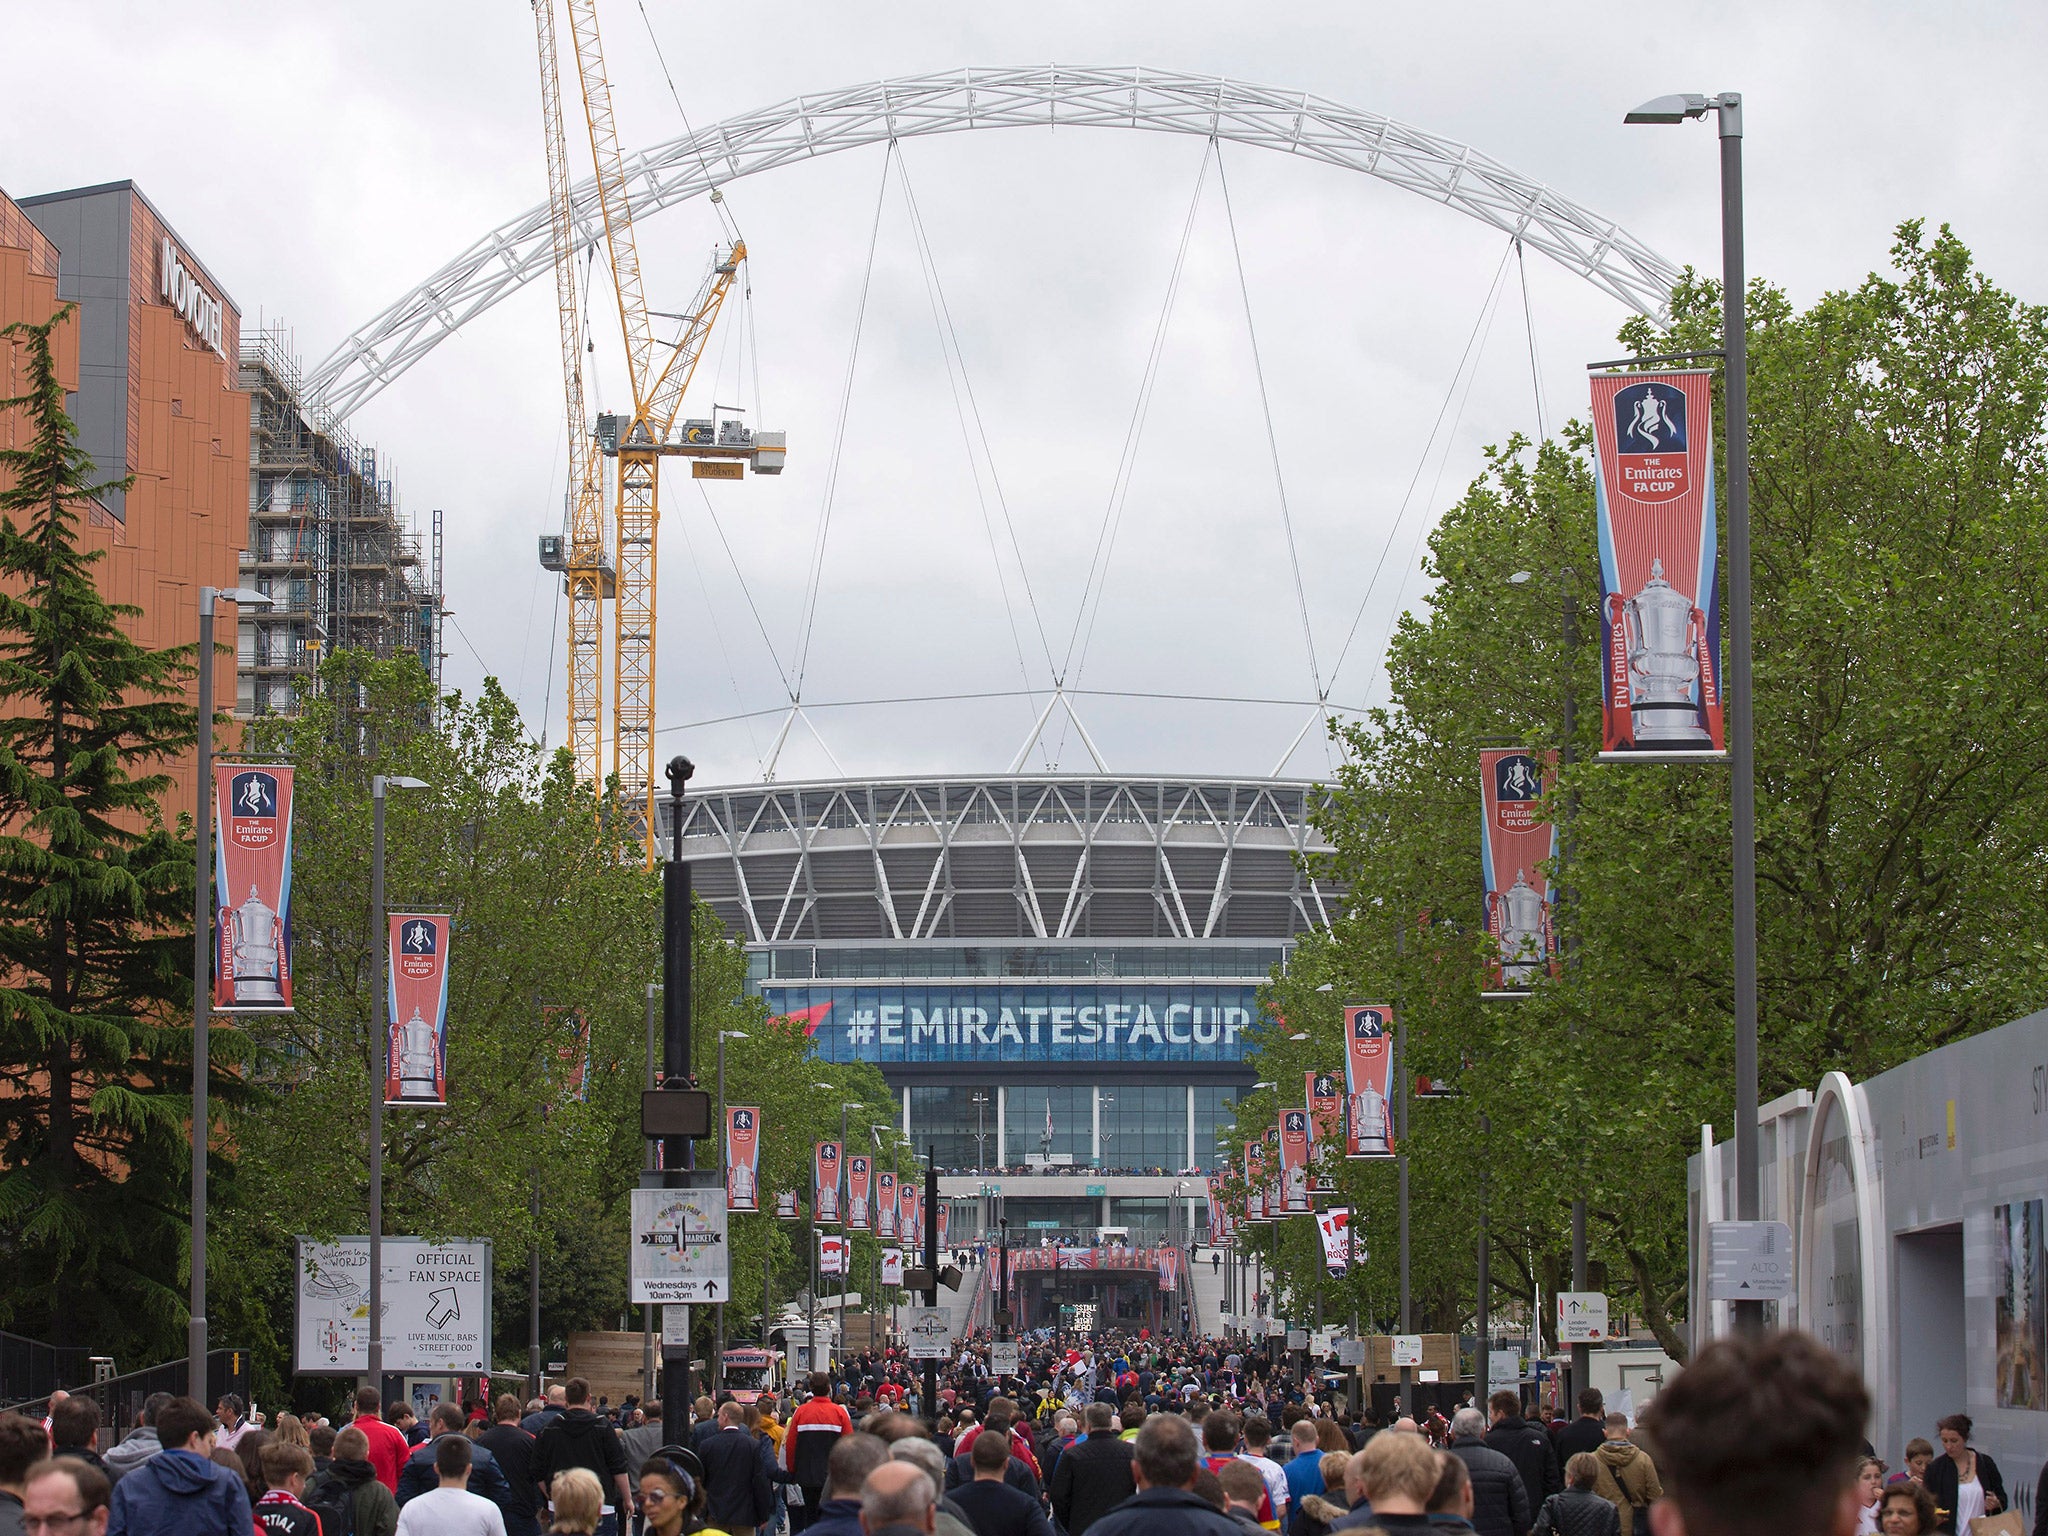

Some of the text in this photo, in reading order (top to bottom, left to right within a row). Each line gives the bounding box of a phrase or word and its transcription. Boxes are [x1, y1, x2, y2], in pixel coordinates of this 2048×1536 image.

[161, 237, 226, 361] NOVOTEL
[1644, 458, 1661, 466] THE
[1624, 466, 1683, 480] Emirates
[1634, 481, 1675, 493] FA CUP
[1613, 622, 1631, 709] Fly Emirates
[1698, 634, 1717, 707] Fly Emirates
[1501, 809, 1534, 818] Emirat
[236, 825, 273, 835] Emirates
[241, 835, 252, 843] FA
[223, 924, 234, 981] Fly Emirates
[278, 934, 287, 966] Emirates
[403, 960, 433, 968] Emirates
[846, 1002, 1250, 1046] #EMIRATESFACUP
[391, 1037, 399, 1068] Emirates
[655, 1234, 712, 1243] FOOD MARKET
[330, 1256, 368, 1268] WORLD
[416, 1253, 475, 1266] OFFICIAL
[1751, 1262, 1779, 1273] ALTO
[409, 1270, 482, 1283] FAN SPACE
[643, 1281, 698, 1291] Wednesdays
[649, 1290, 693, 1301] 10am-3pm
[408, 1333, 478, 1342] LIVE MUSIC, BARS
[419, 1343, 450, 1352] STREET
[451, 1343, 473, 1352] FOOD
[262, 1514, 295, 1534] RTIAL
